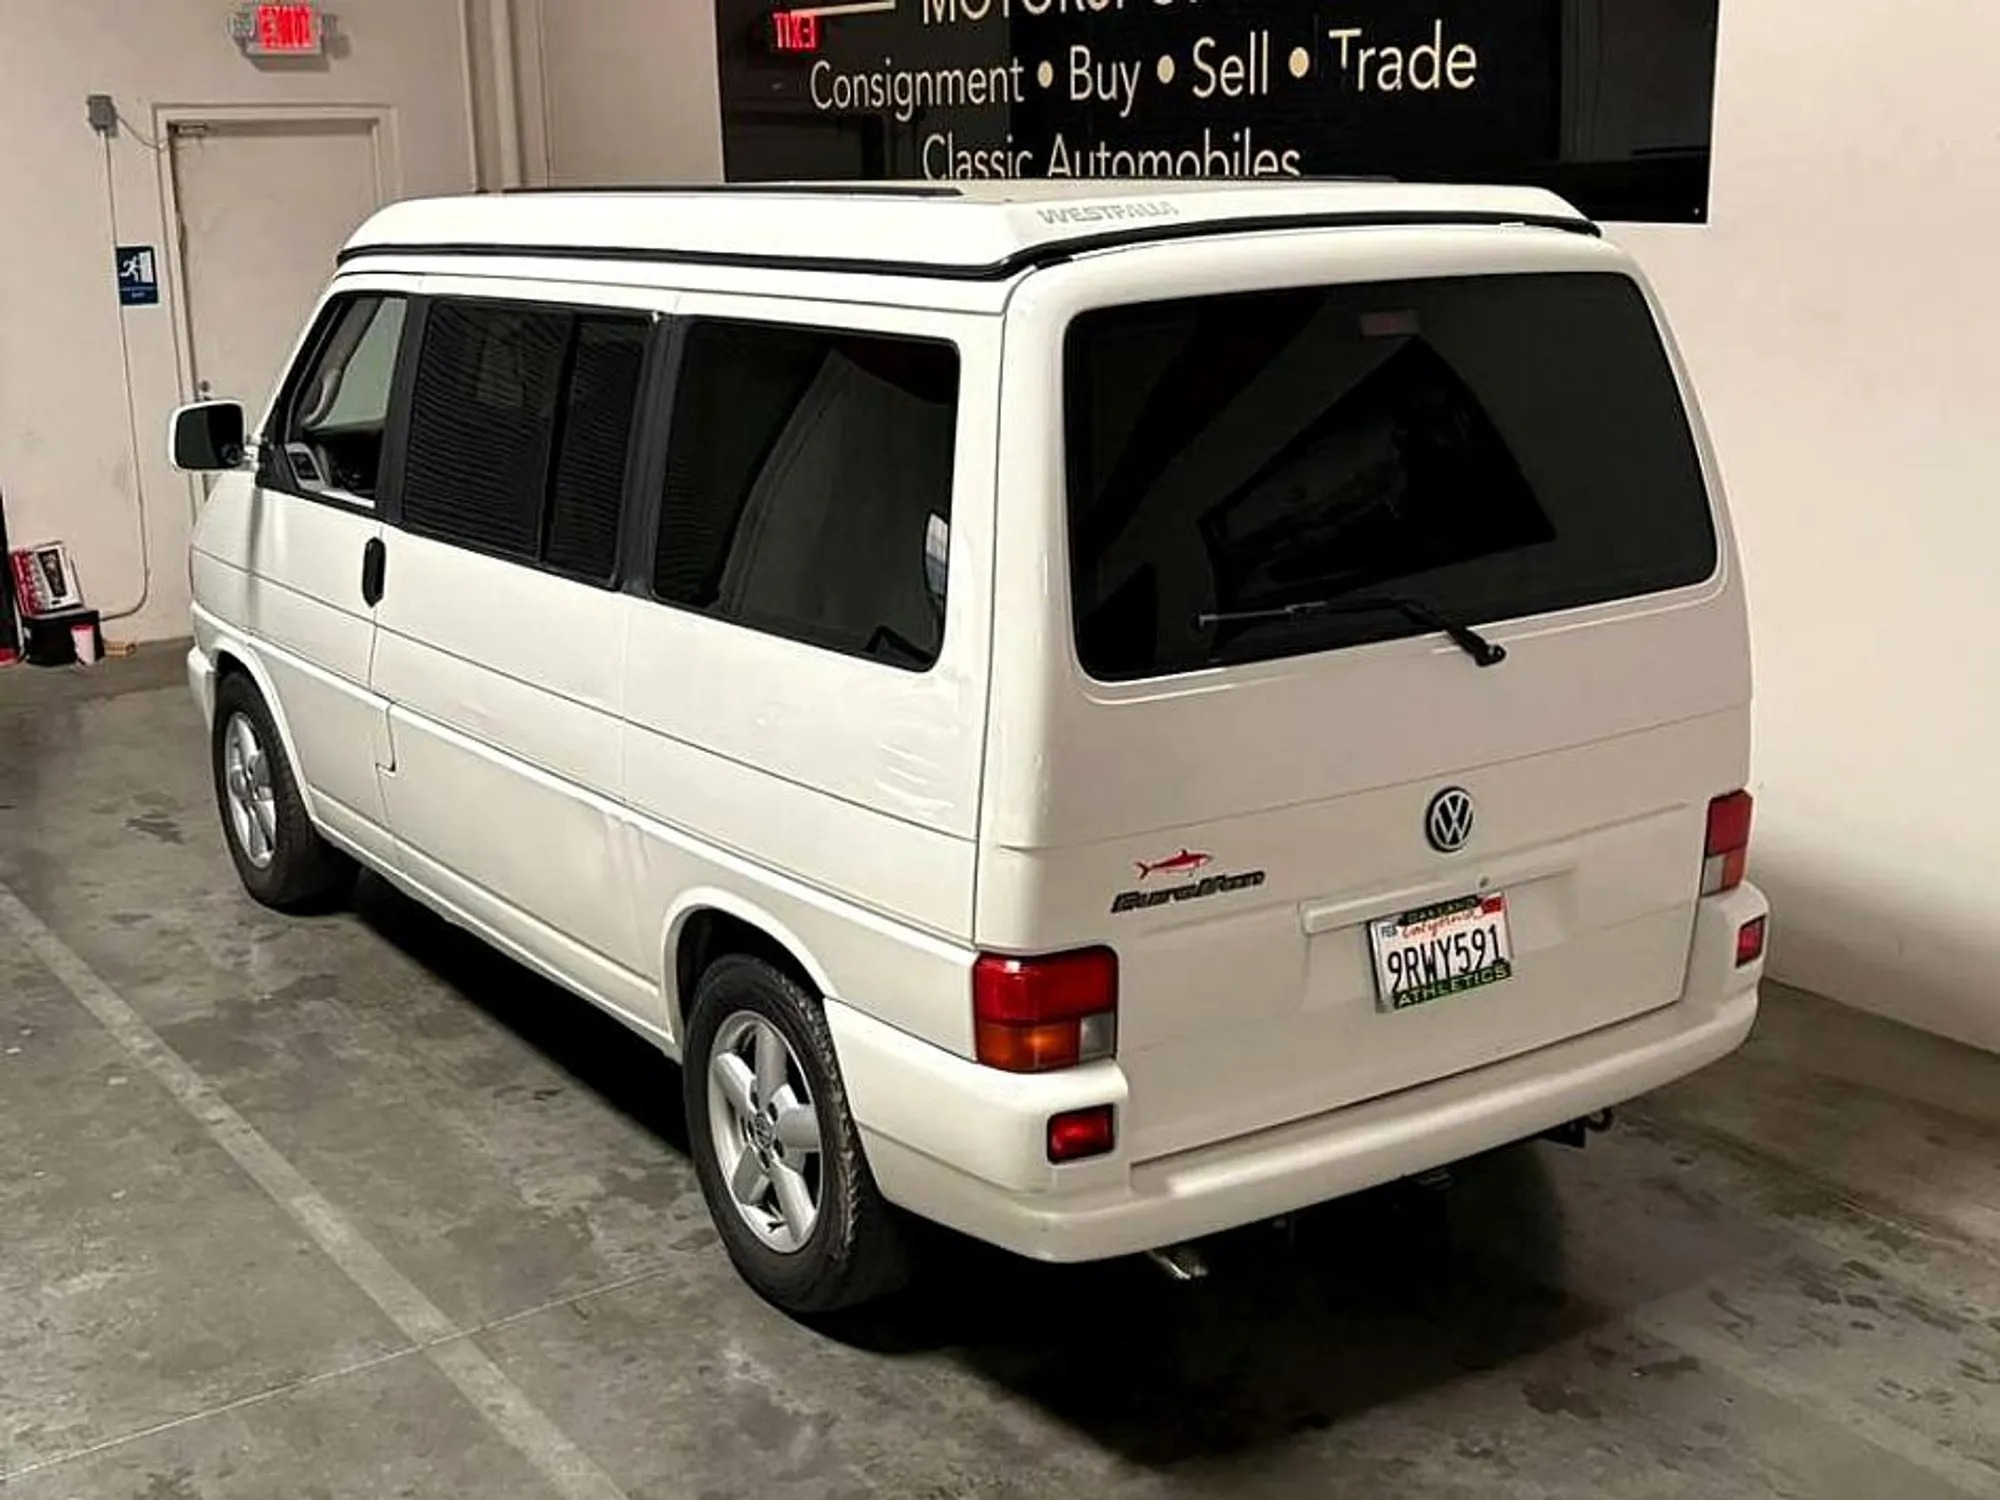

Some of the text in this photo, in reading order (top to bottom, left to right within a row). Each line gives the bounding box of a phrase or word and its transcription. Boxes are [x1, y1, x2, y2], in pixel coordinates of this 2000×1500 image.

[809, 18, 1477, 122] Consignment Buy Sell Trade
[923, 126, 1301, 180] Classic Automobiles
[1387, 923, 1501, 994] 9RWY591
